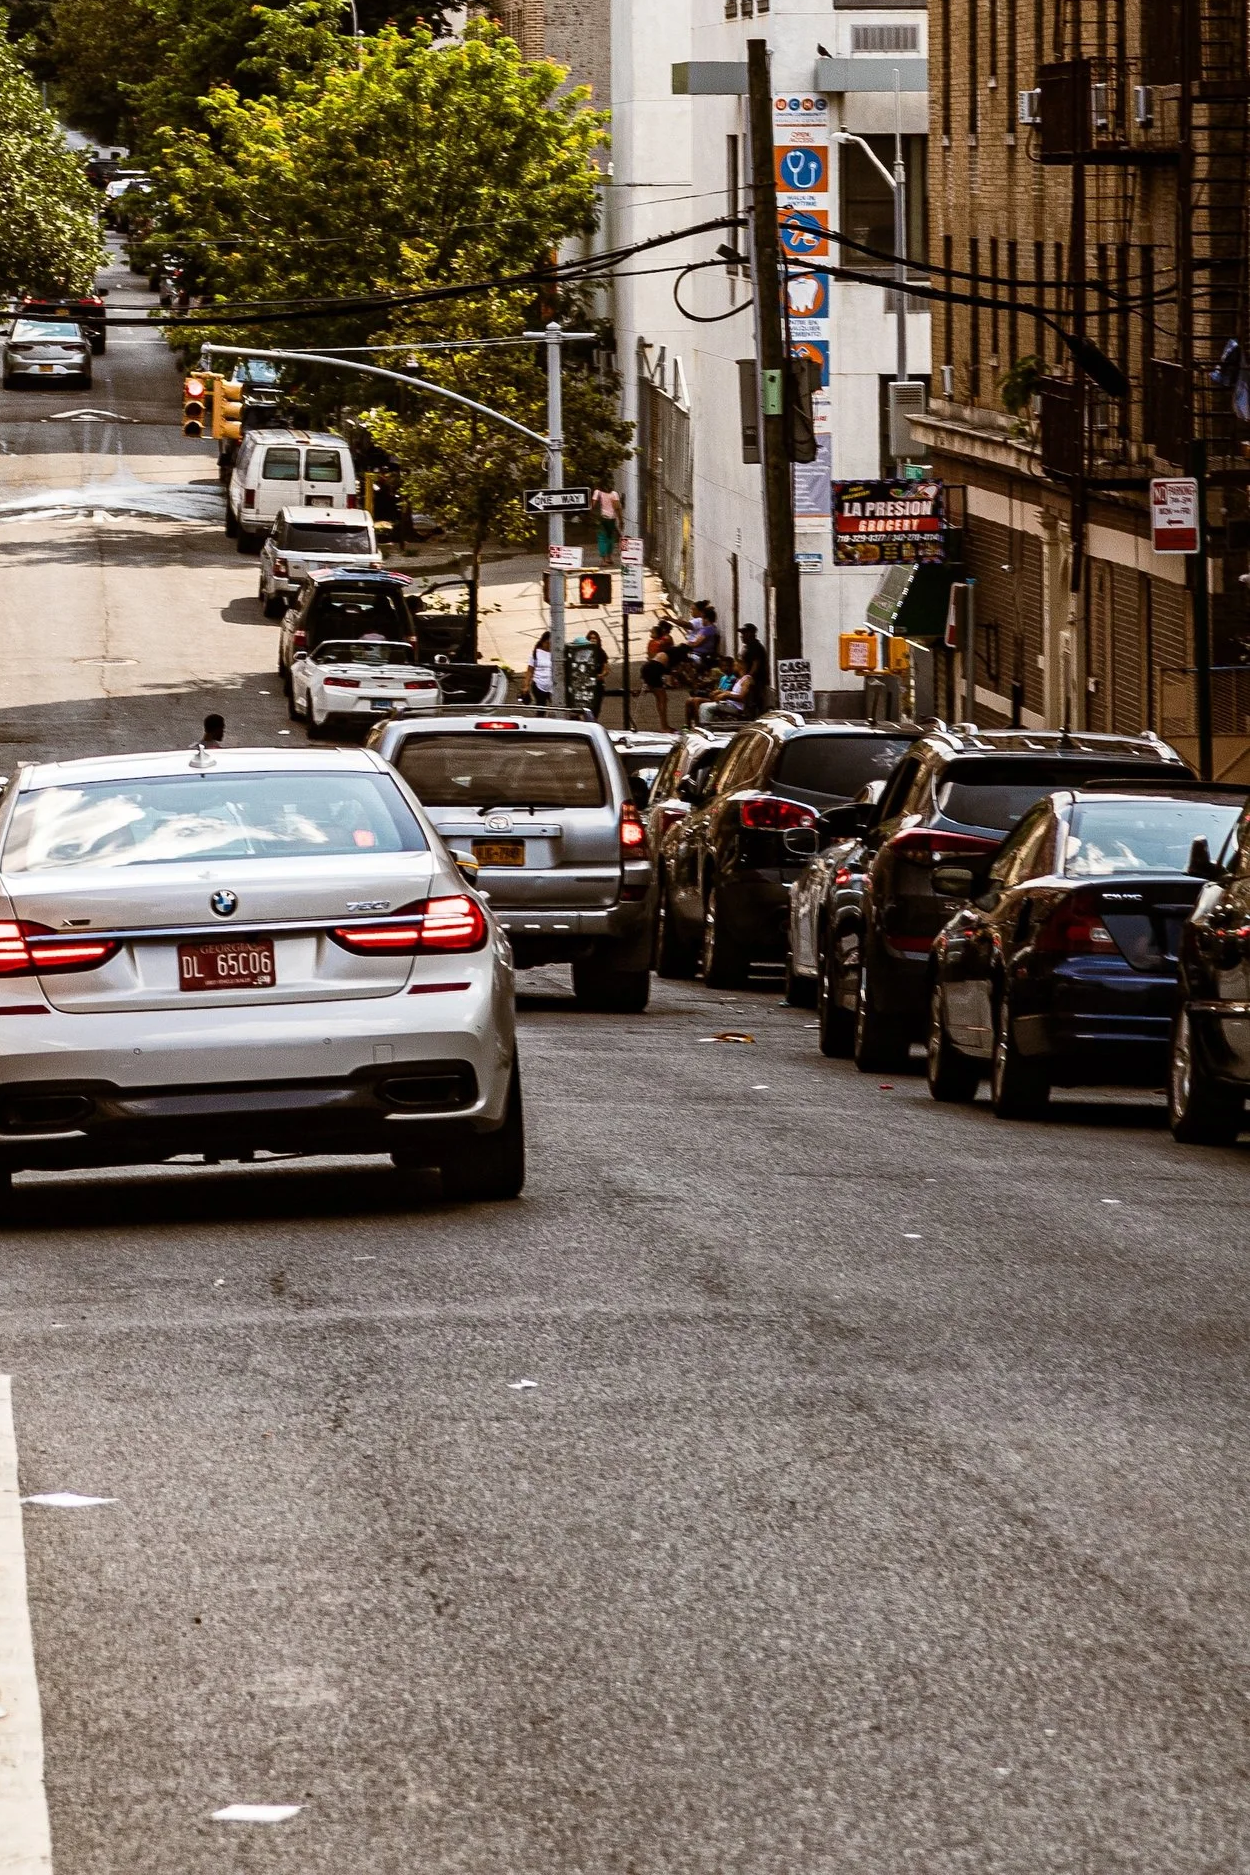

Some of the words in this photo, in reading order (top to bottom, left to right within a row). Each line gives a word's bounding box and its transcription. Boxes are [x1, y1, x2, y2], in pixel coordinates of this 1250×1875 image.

[534, 496, 554, 505] ONE
[561, 495, 582, 504] WAY
[843, 502, 862, 517] LA
[864, 500, 934, 517] PRESION
[858, 519, 920, 532] GROCERY
[780, 661, 811, 673] CASH
[781, 683, 812, 692] CARS
[182, 956, 205, 978] DL
[217, 951, 272, 976] 65C06
